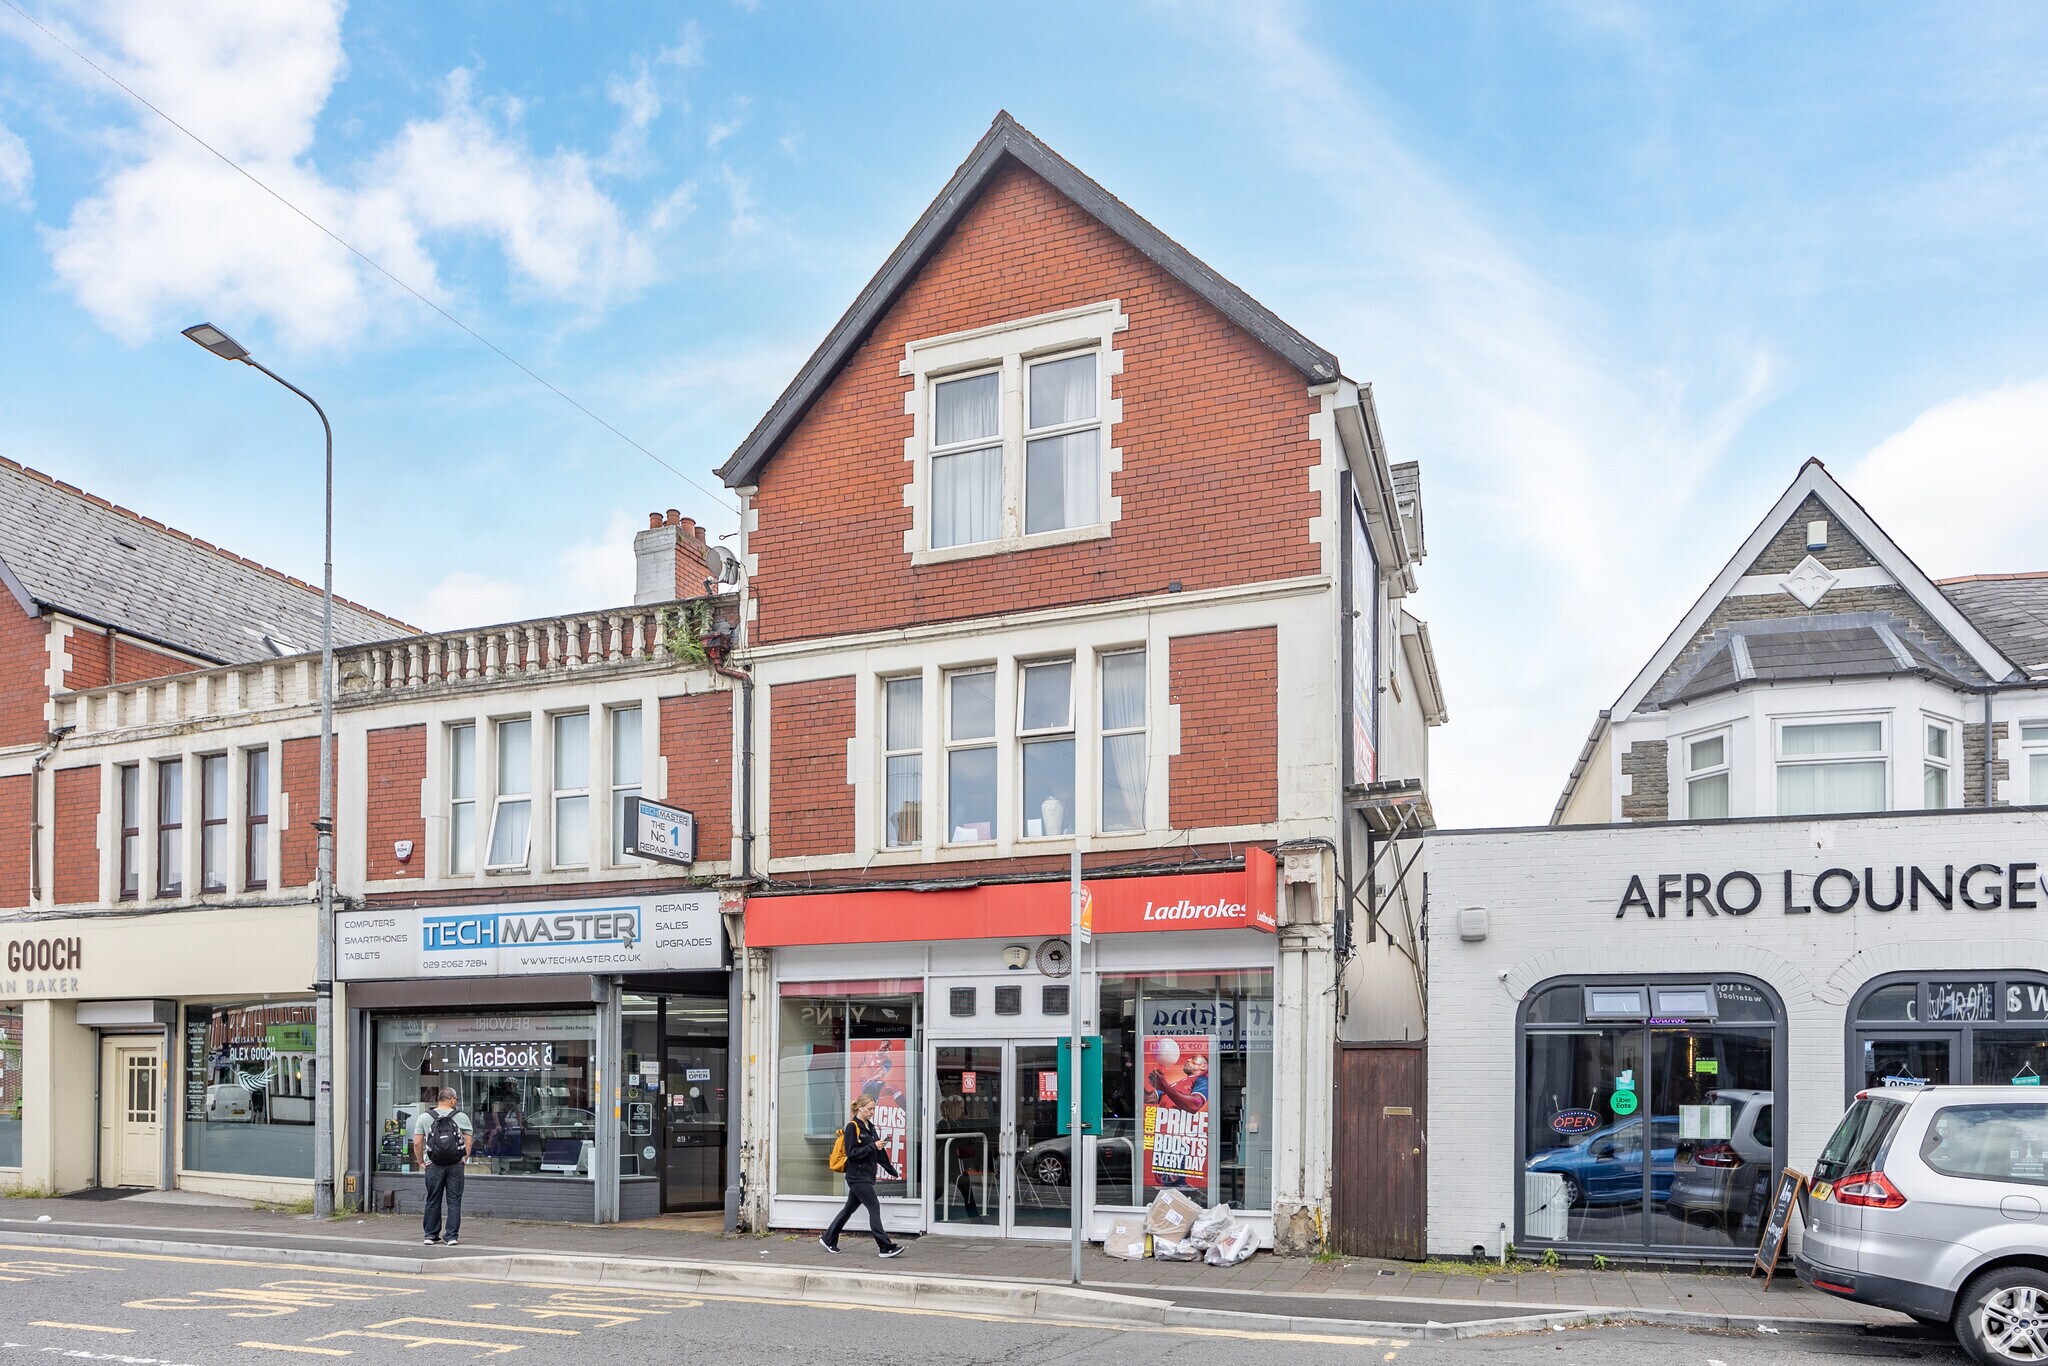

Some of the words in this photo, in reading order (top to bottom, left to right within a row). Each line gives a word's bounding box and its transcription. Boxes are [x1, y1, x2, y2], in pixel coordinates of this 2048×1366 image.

[651, 820, 666, 831] THE
[671, 826, 679, 847] 1
[640, 842, 667, 855] REPAIR
[668, 849, 690, 859] SHOP
[1615, 871, 1762, 918] AFRO
[1784, 863, 2038, 914] LOUNGE
[655, 903, 699, 913] REPAIRS
[1144, 899, 1246, 920] Ladbrokes
[344, 919, 396, 929] COMPUTERS
[655, 921, 689, 931] SALES
[1257, 909, 1276, 927] Ladbrokes
[344, 934, 408, 945] SMARTPHONES
[655, 938, 713, 948] UPGRADES
[8, 937, 81, 972] GOOCH
[344, 952, 381, 960] TABLETS
[521, 953, 641, 966] WWW.TECHMASTER.CO.UK
[423, 961, 440, 969] 029
[441, 960, 464, 968] 2062
[465, 959, 487, 968] 7284
[26, 977, 78, 994] BAKER
[229, 1047, 249, 1061] ALEX
[250, 1046, 276, 1060] GOOCH
[458, 1046, 539, 1067] MacBook
[1144, 1106, 1157, 1134] EUROS
[1155, 1107, 1208, 1138] PRICE
[1553, 1116, 1597, 1128] OPEN
[1143, 1134, 1155, 1151] THE
[1153, 1133, 1208, 1158] BOOSTS
[1152, 1151, 1184, 1169] EVERY
[1184, 1155, 1206, 1172] DAY
